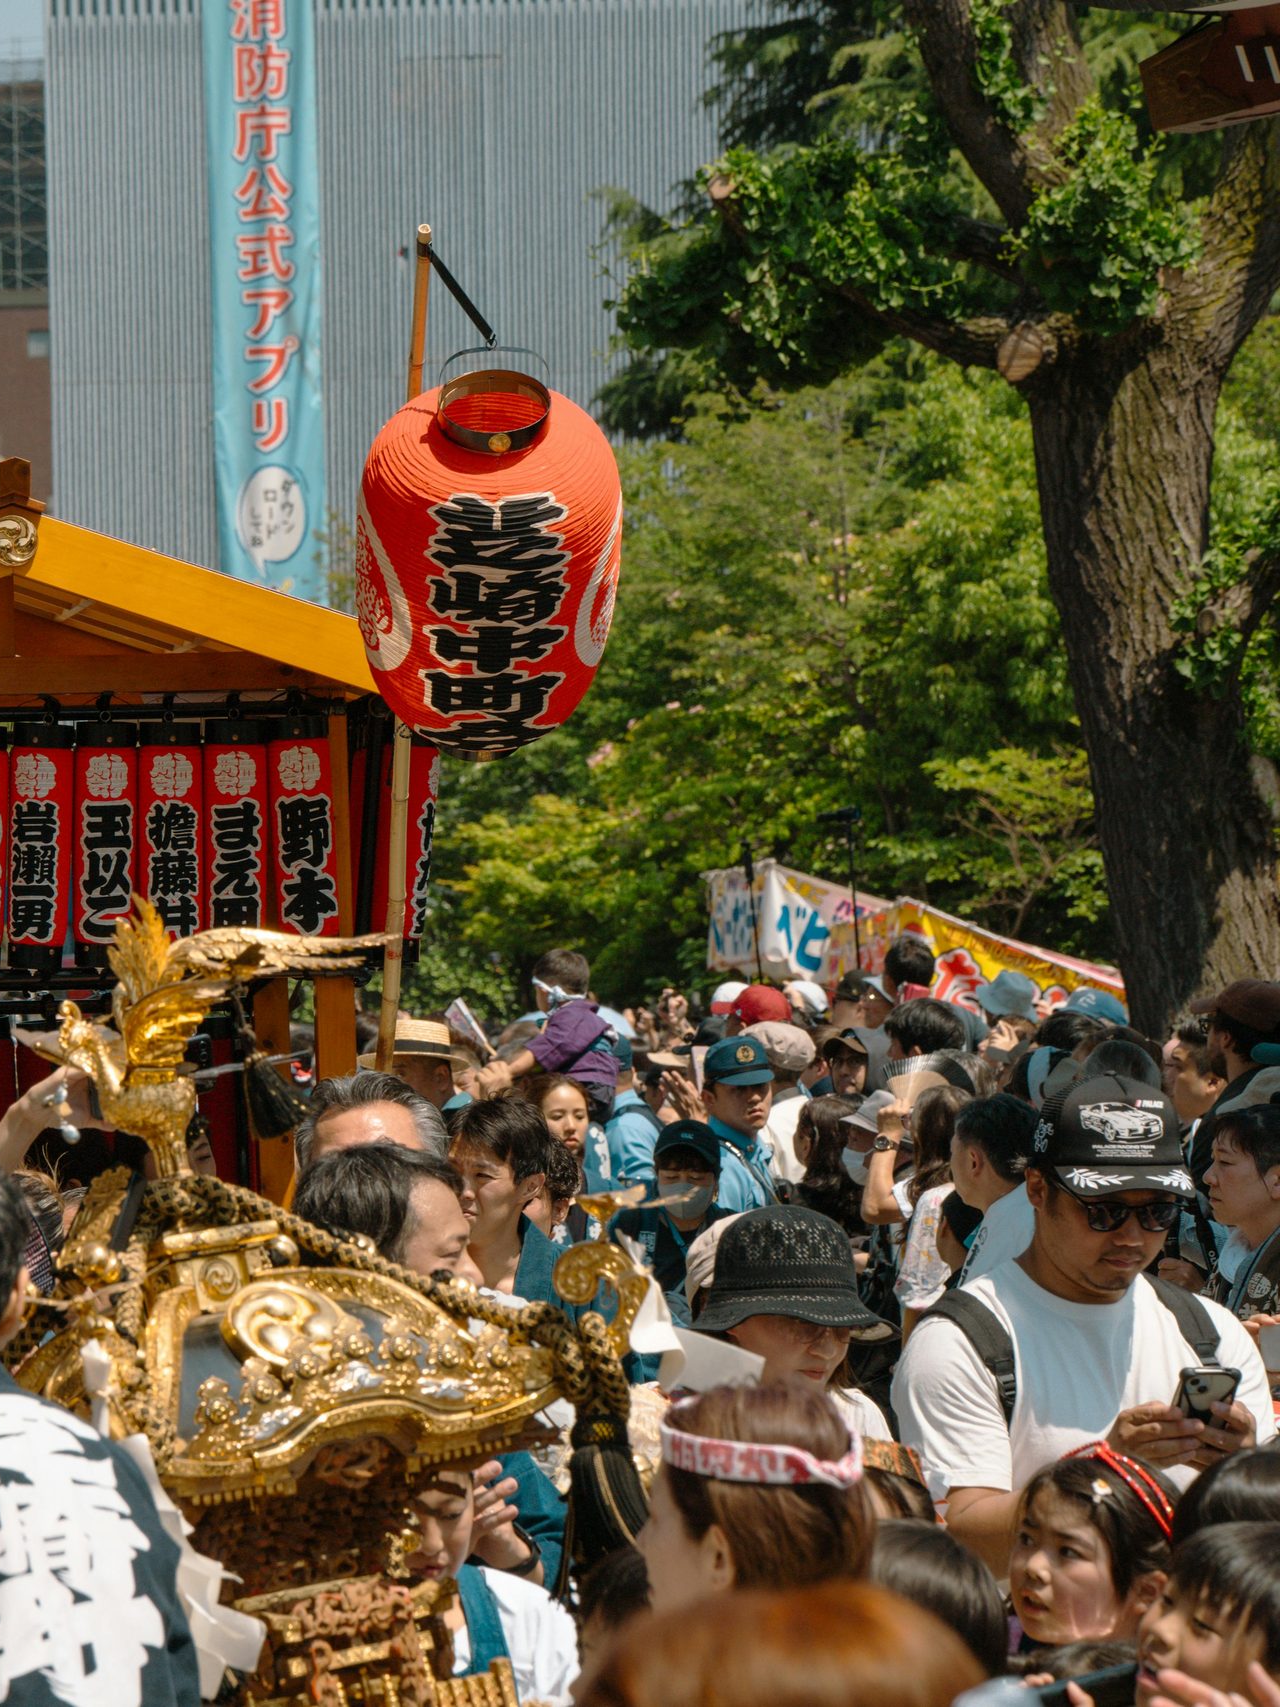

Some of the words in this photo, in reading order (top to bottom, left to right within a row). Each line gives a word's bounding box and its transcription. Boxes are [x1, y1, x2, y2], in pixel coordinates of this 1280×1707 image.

[231, 0, 299, 453] 消防庁公式アプリ
[275, 793, 338, 936] 野本
